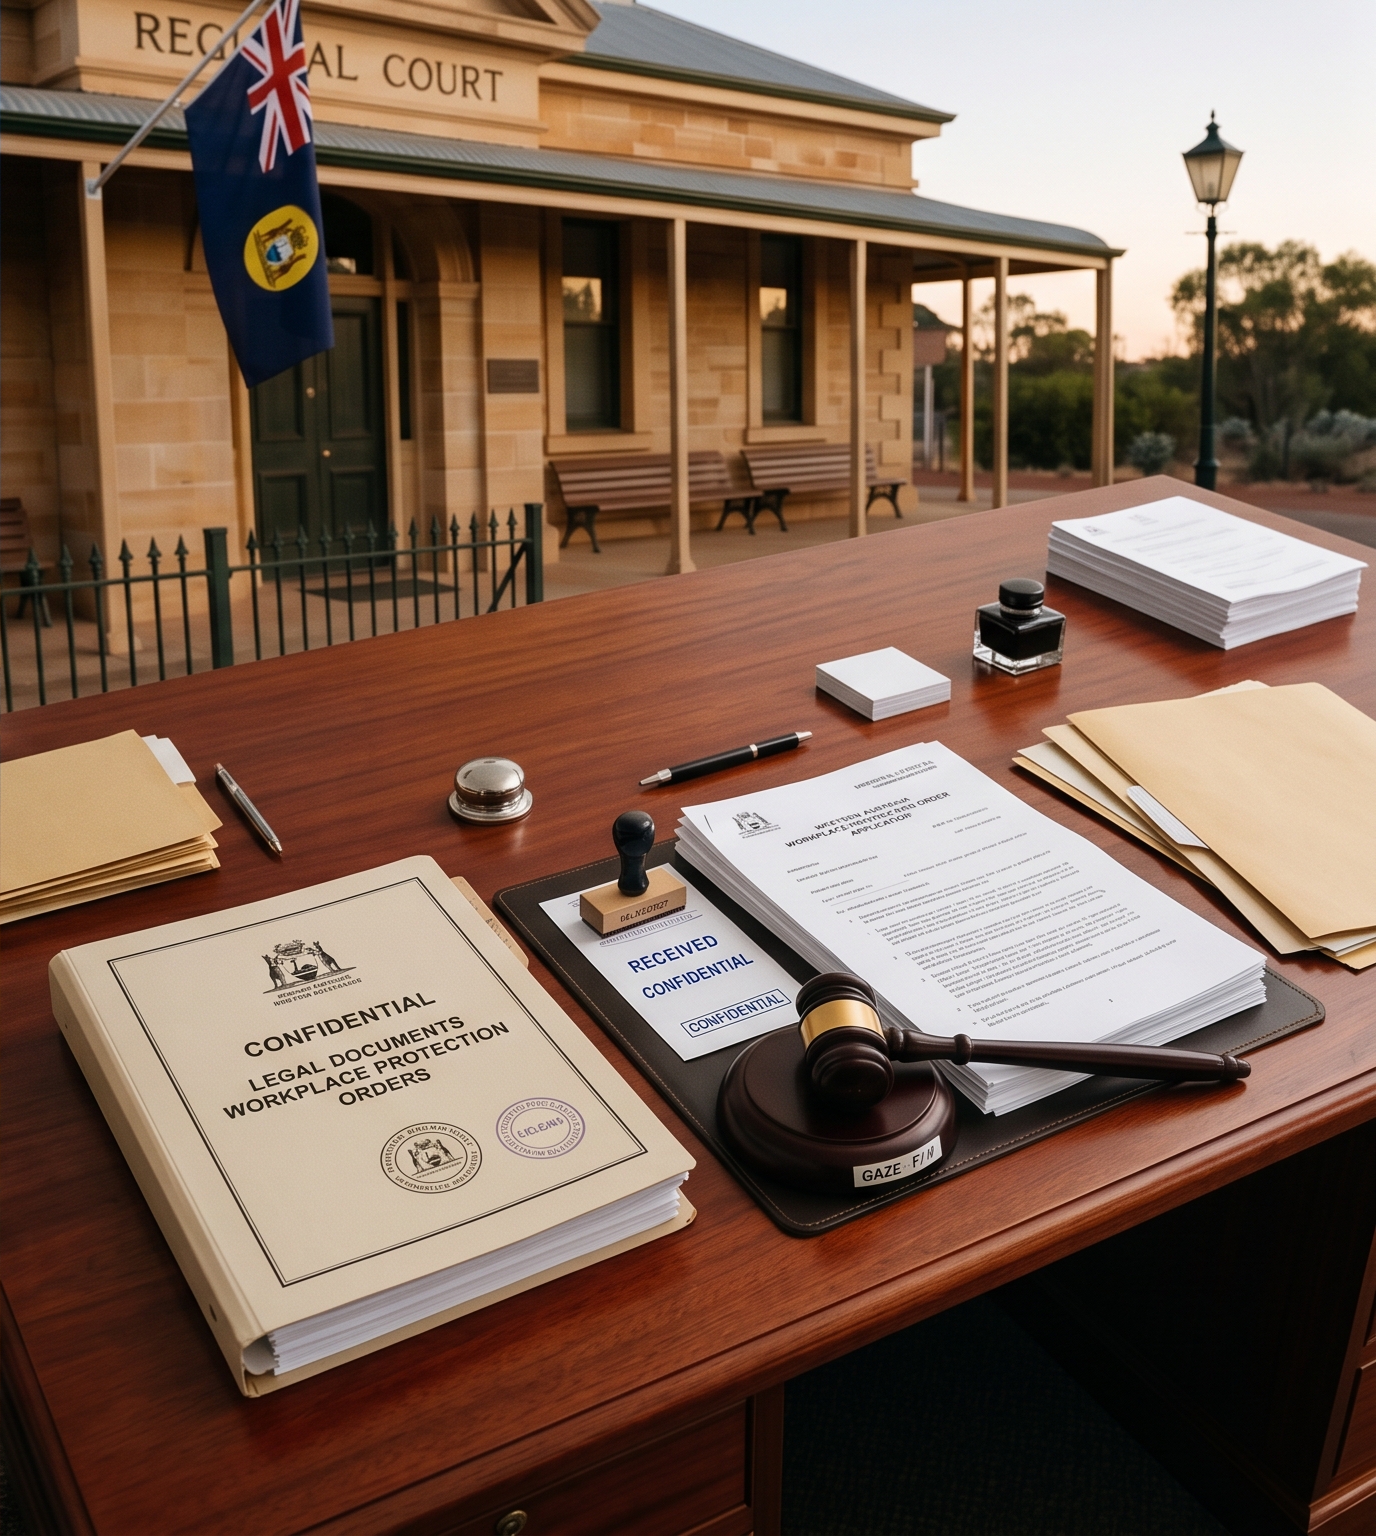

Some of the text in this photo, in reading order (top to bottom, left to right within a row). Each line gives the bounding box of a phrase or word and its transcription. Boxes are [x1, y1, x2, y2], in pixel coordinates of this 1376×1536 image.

[382, 53, 504, 102] COURT
[627, 935, 719, 973] RECEIVED
[642, 953, 754, 999] CONFIDENTIAL
[243, 992, 436, 1058] CONFIDENTIAL
[688, 993, 785, 1033] CONFIDENTIAL
[222, 1021, 510, 1120] WORKPLACE PROTECTION
[248, 1016, 465, 1092] LEGAL DOCUMENTS
[338, 1068, 431, 1106] ORDERS
[862, 1162, 902, 1182] GAZE
